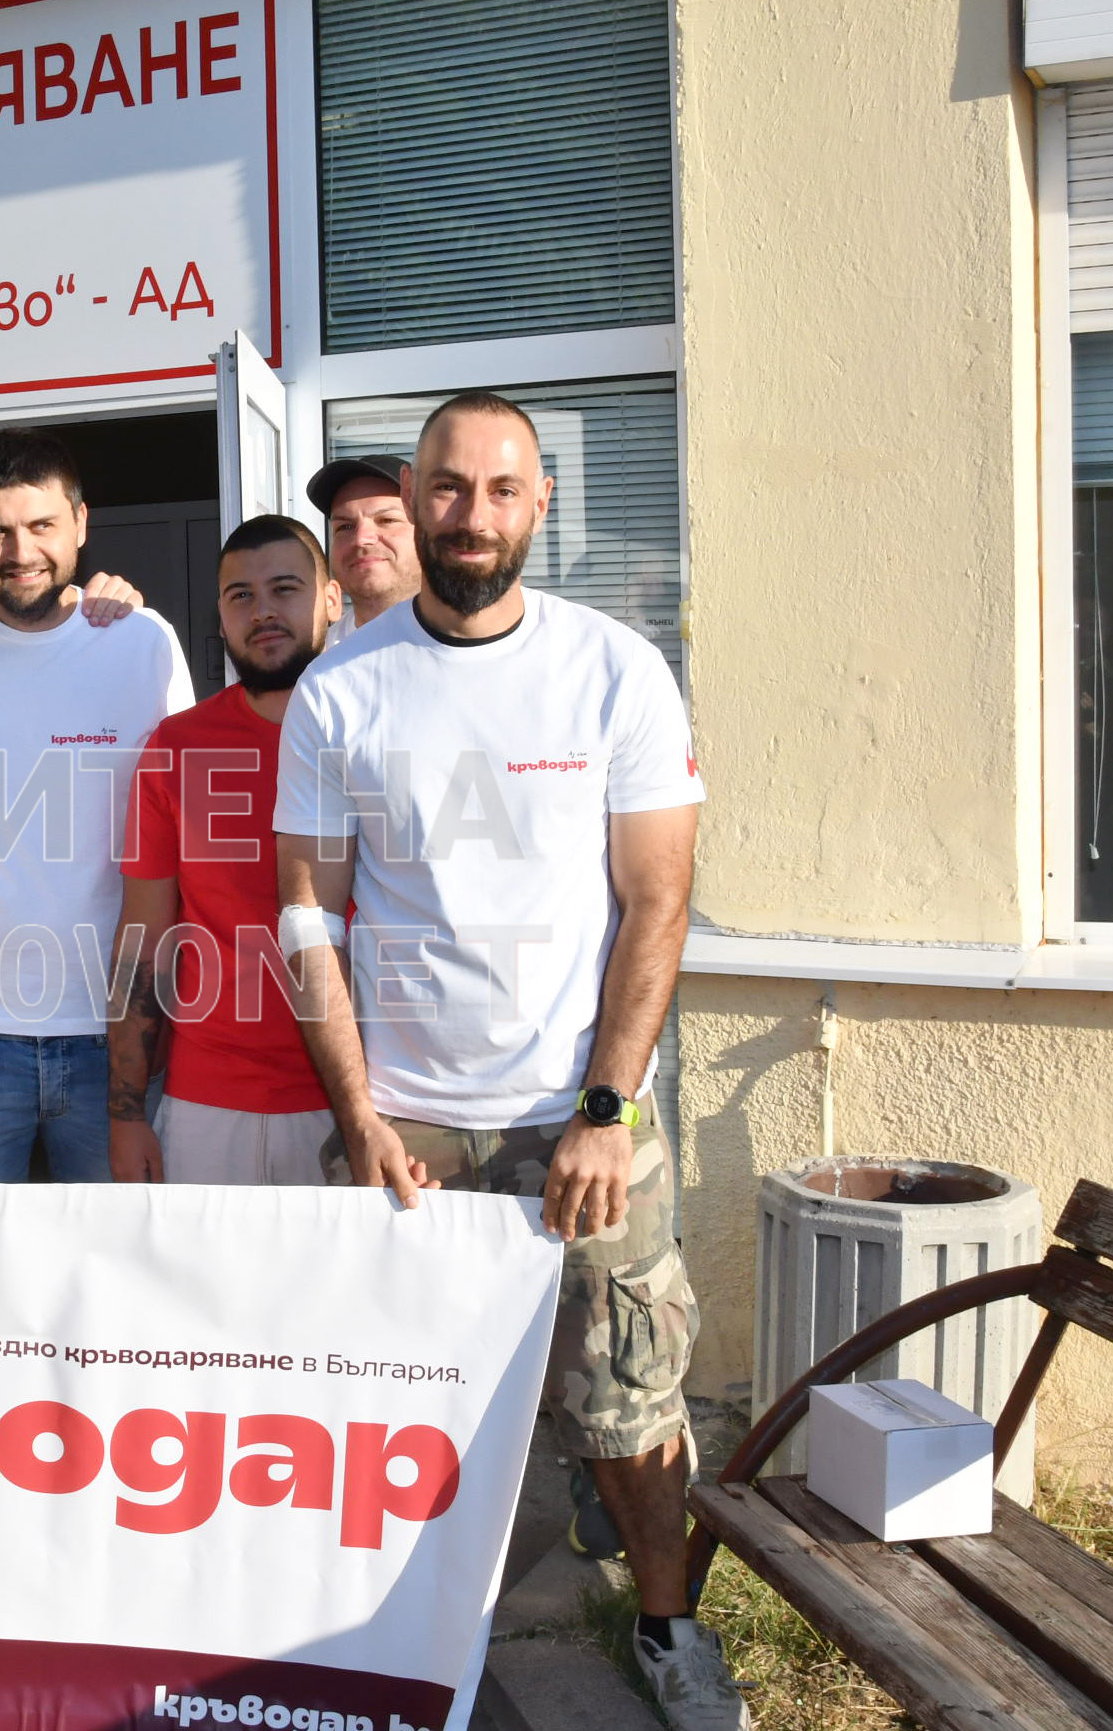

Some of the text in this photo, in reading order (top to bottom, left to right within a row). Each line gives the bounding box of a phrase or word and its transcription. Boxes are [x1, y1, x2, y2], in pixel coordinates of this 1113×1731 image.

[129, 261, 215, 321] АД
[51, 734, 118, 746] кръводар
[507, 760, 588, 774] кръводар
[64, 1346, 294, 1371] кръводаряване
[302, 1357, 317, 1373] в
[326, 1354, 467, 1384] България.
